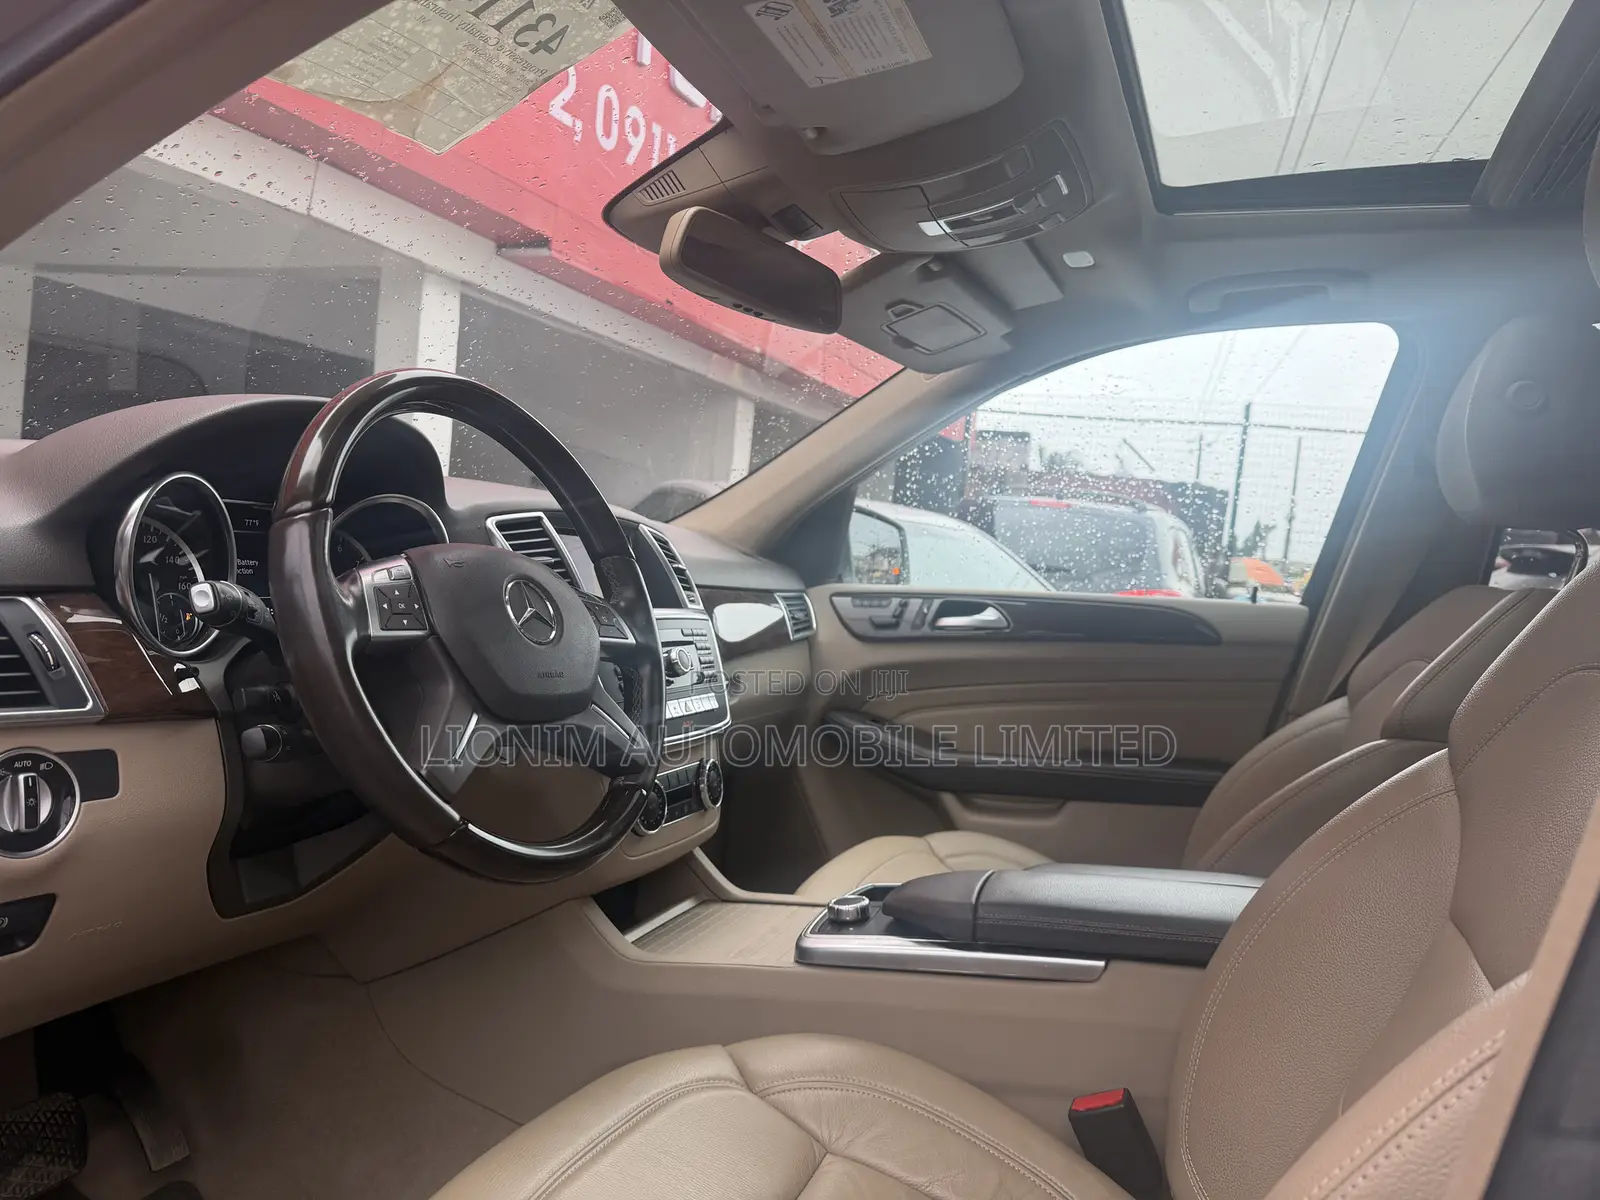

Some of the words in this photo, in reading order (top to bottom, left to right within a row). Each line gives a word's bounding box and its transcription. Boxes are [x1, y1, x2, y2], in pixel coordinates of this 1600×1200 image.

[143, 534, 158, 544] 120
[165, 555, 180, 564] 140
[14, 760, 32, 768] AUTO
